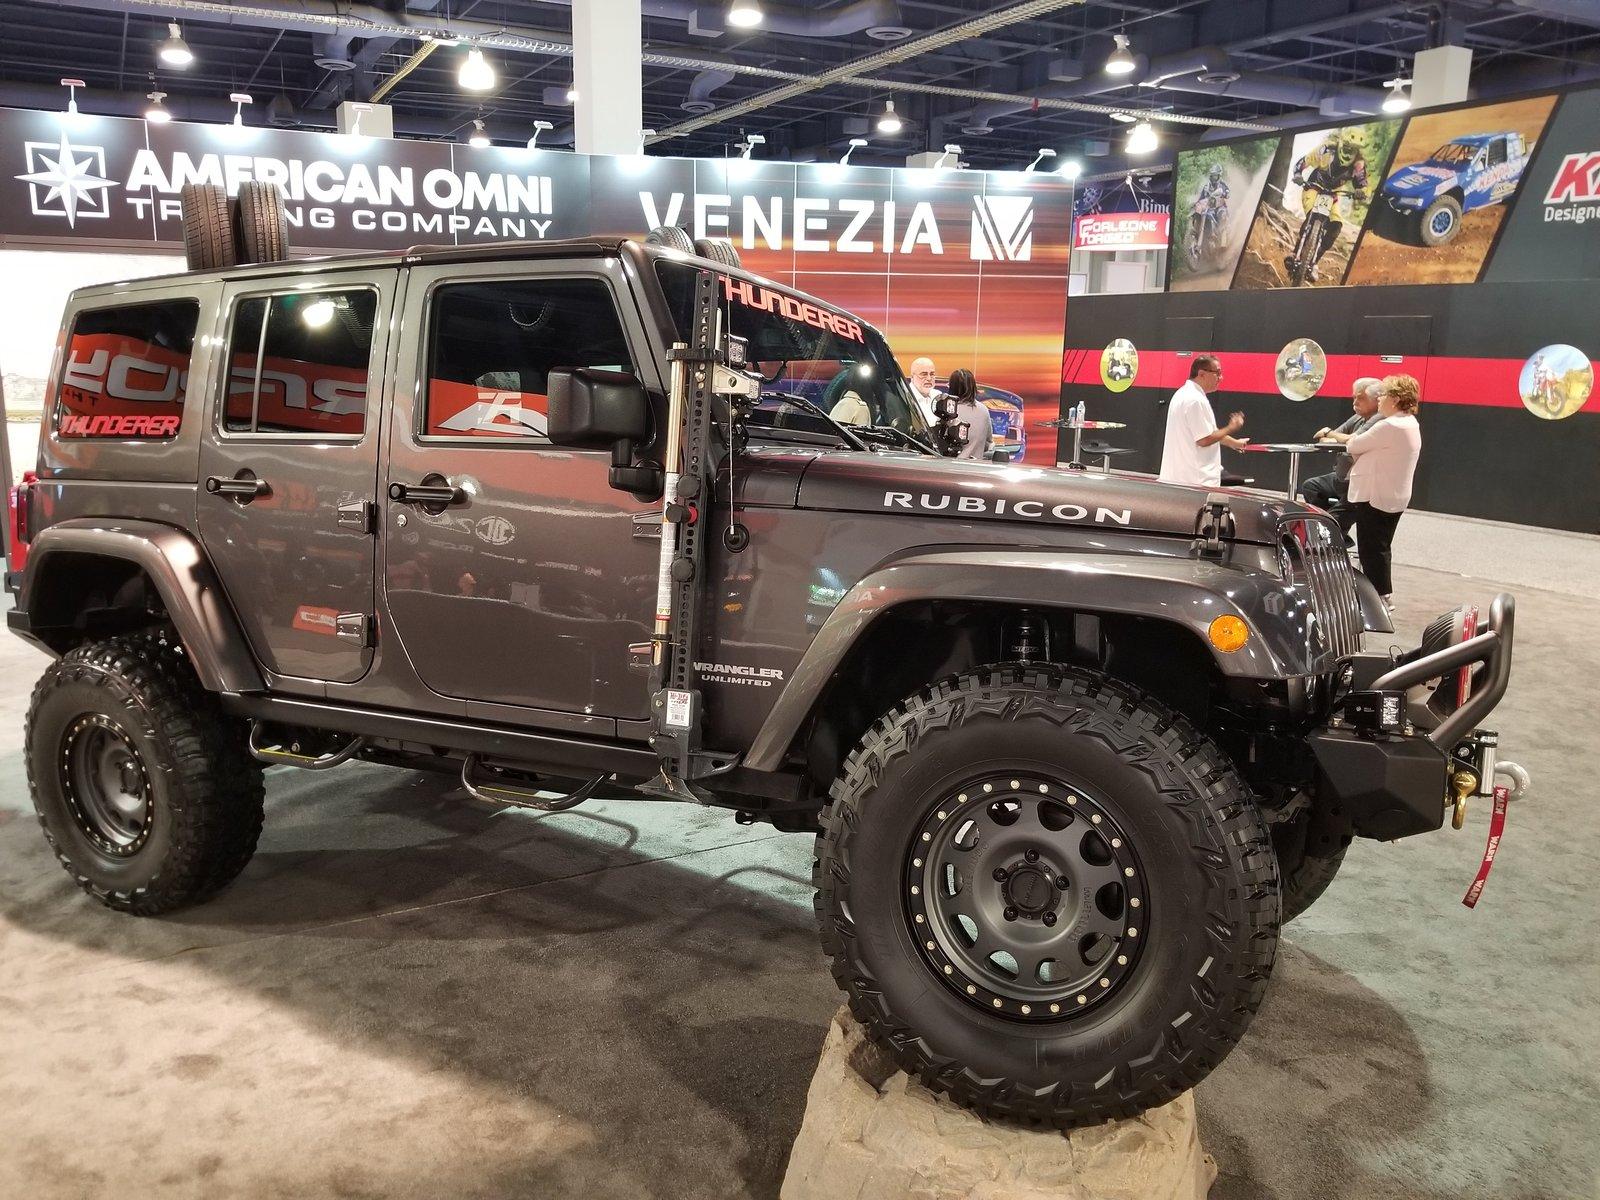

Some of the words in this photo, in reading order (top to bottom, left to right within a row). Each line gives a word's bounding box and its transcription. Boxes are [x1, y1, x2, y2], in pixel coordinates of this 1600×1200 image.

[126, 149, 414, 206] AMERICAN
[422, 168, 553, 215] OMNI
[126, 197, 335, 229] TRNG
[352, 210, 553, 239] COMPANY
[638, 191, 944, 255] VENEZIA
[718, 274, 865, 344] THUNDERER
[59, 415, 180, 436] THUNDERER
[883, 491, 1132, 525] RUBICON
[701, 674, 772, 687] UNLIMITED
[1485, 835, 1499, 862] WARN
